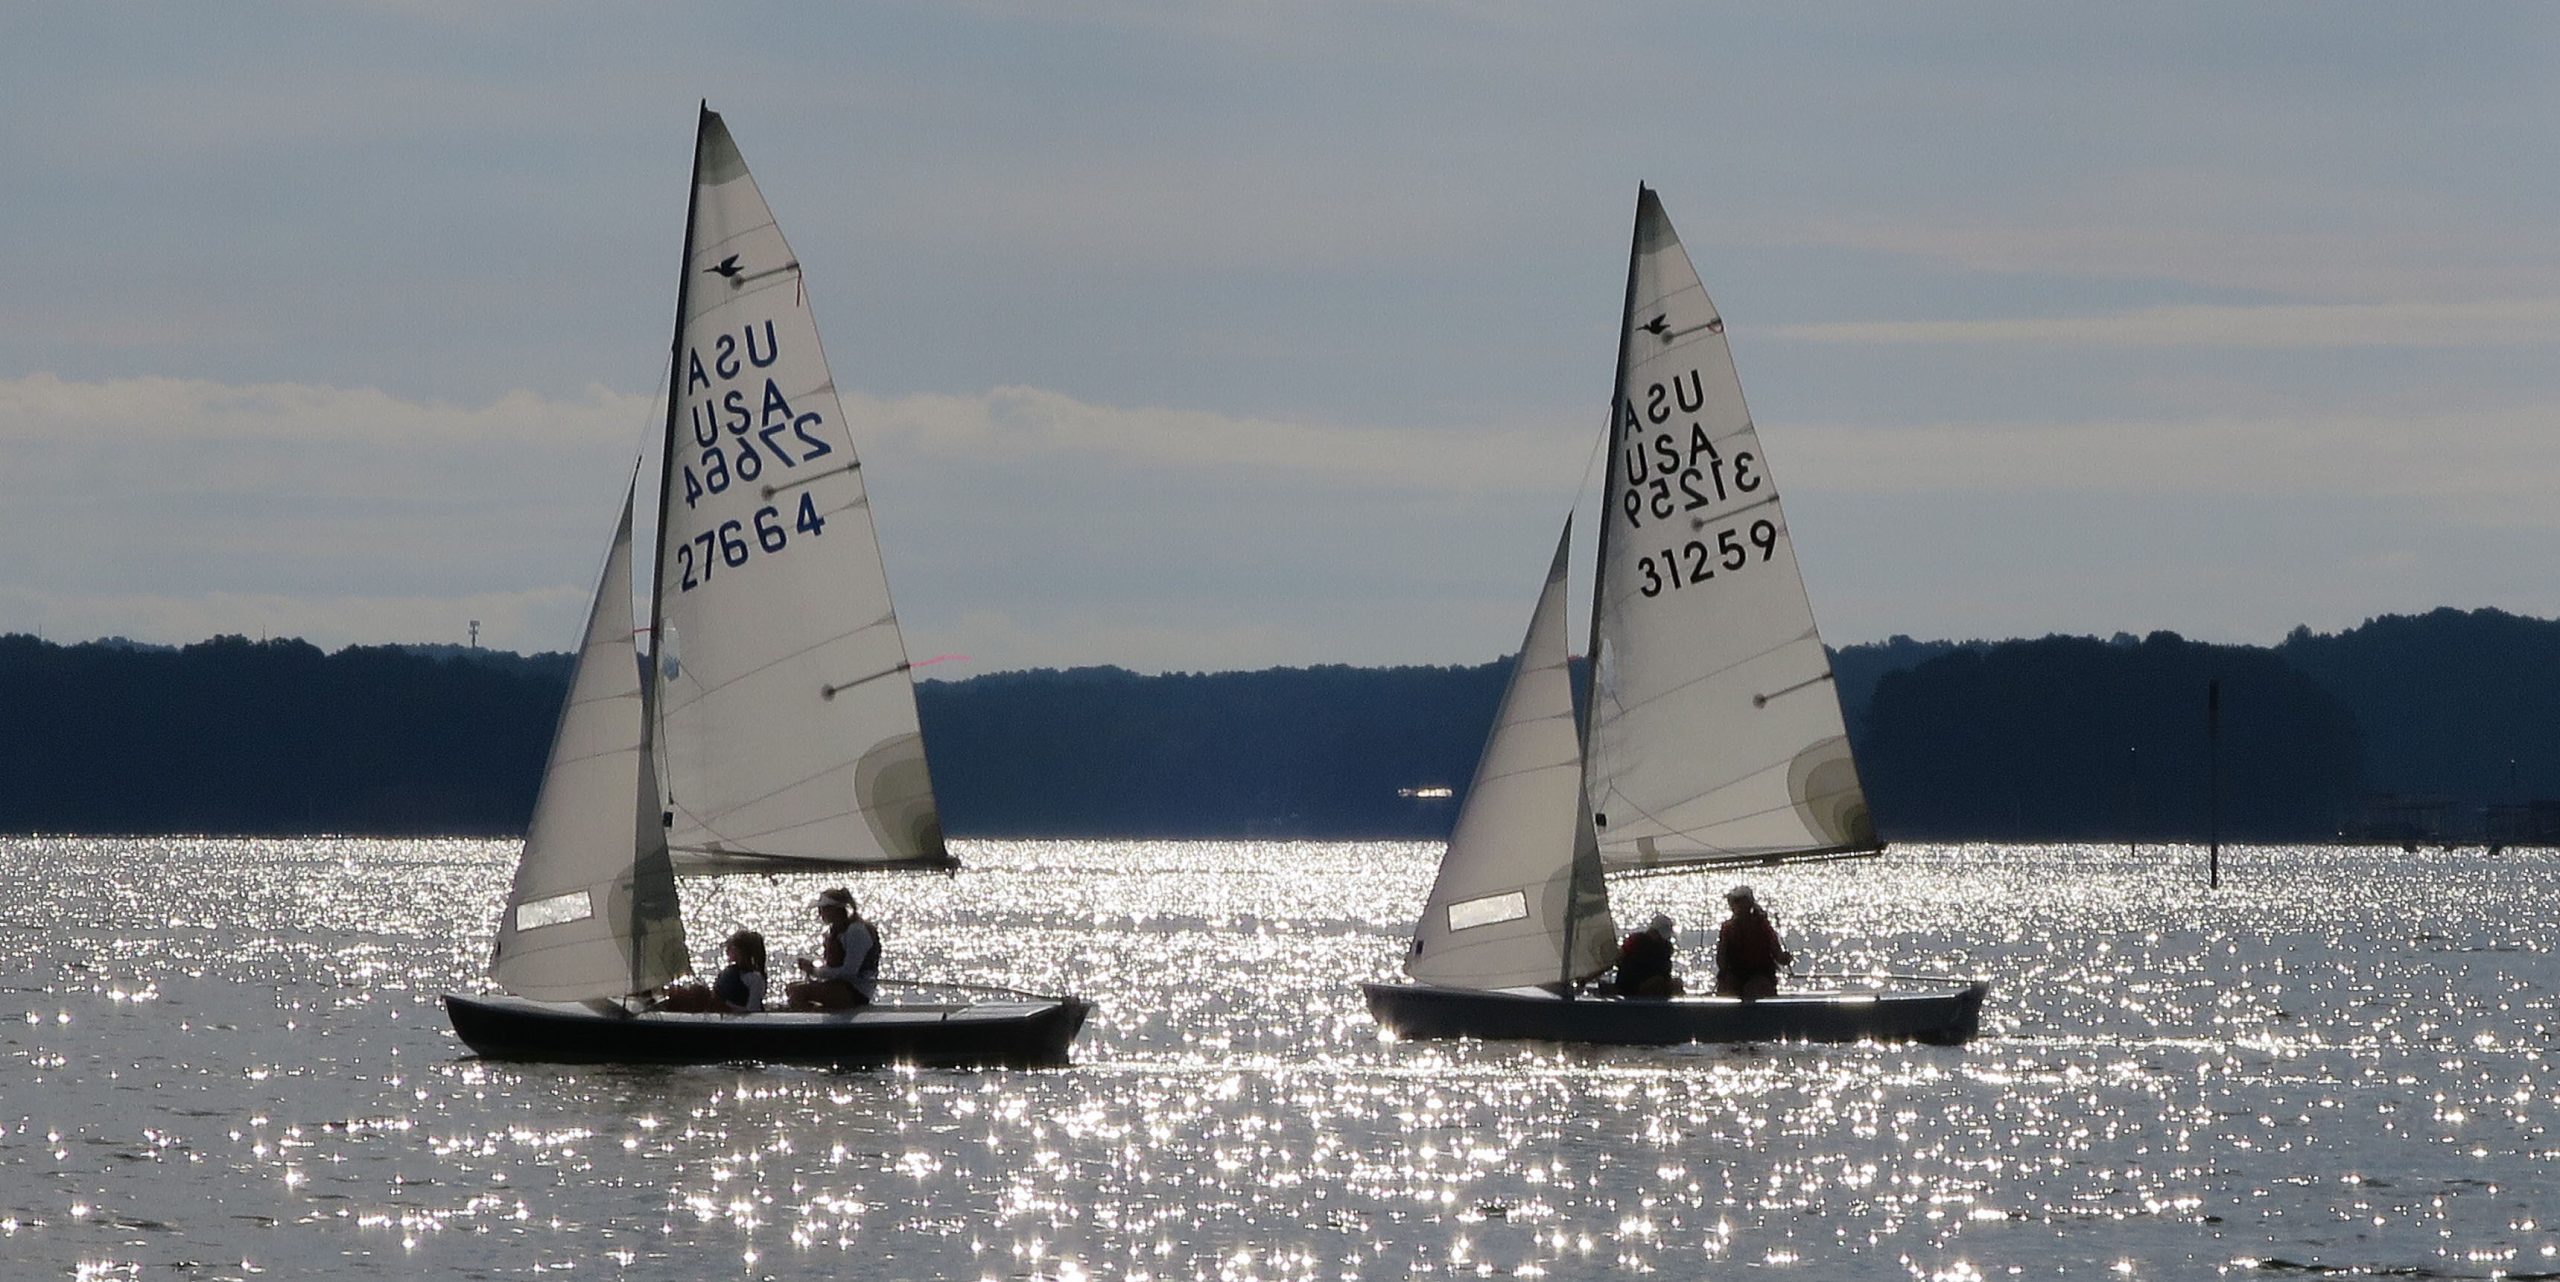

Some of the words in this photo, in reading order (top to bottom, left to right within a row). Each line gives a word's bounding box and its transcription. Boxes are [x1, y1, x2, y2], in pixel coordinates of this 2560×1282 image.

[692, 378, 794, 448] USA
[1625, 422, 1718, 486] USA
[678, 491, 825, 593] 27664
[1638, 519, 1776, 597] 31259
